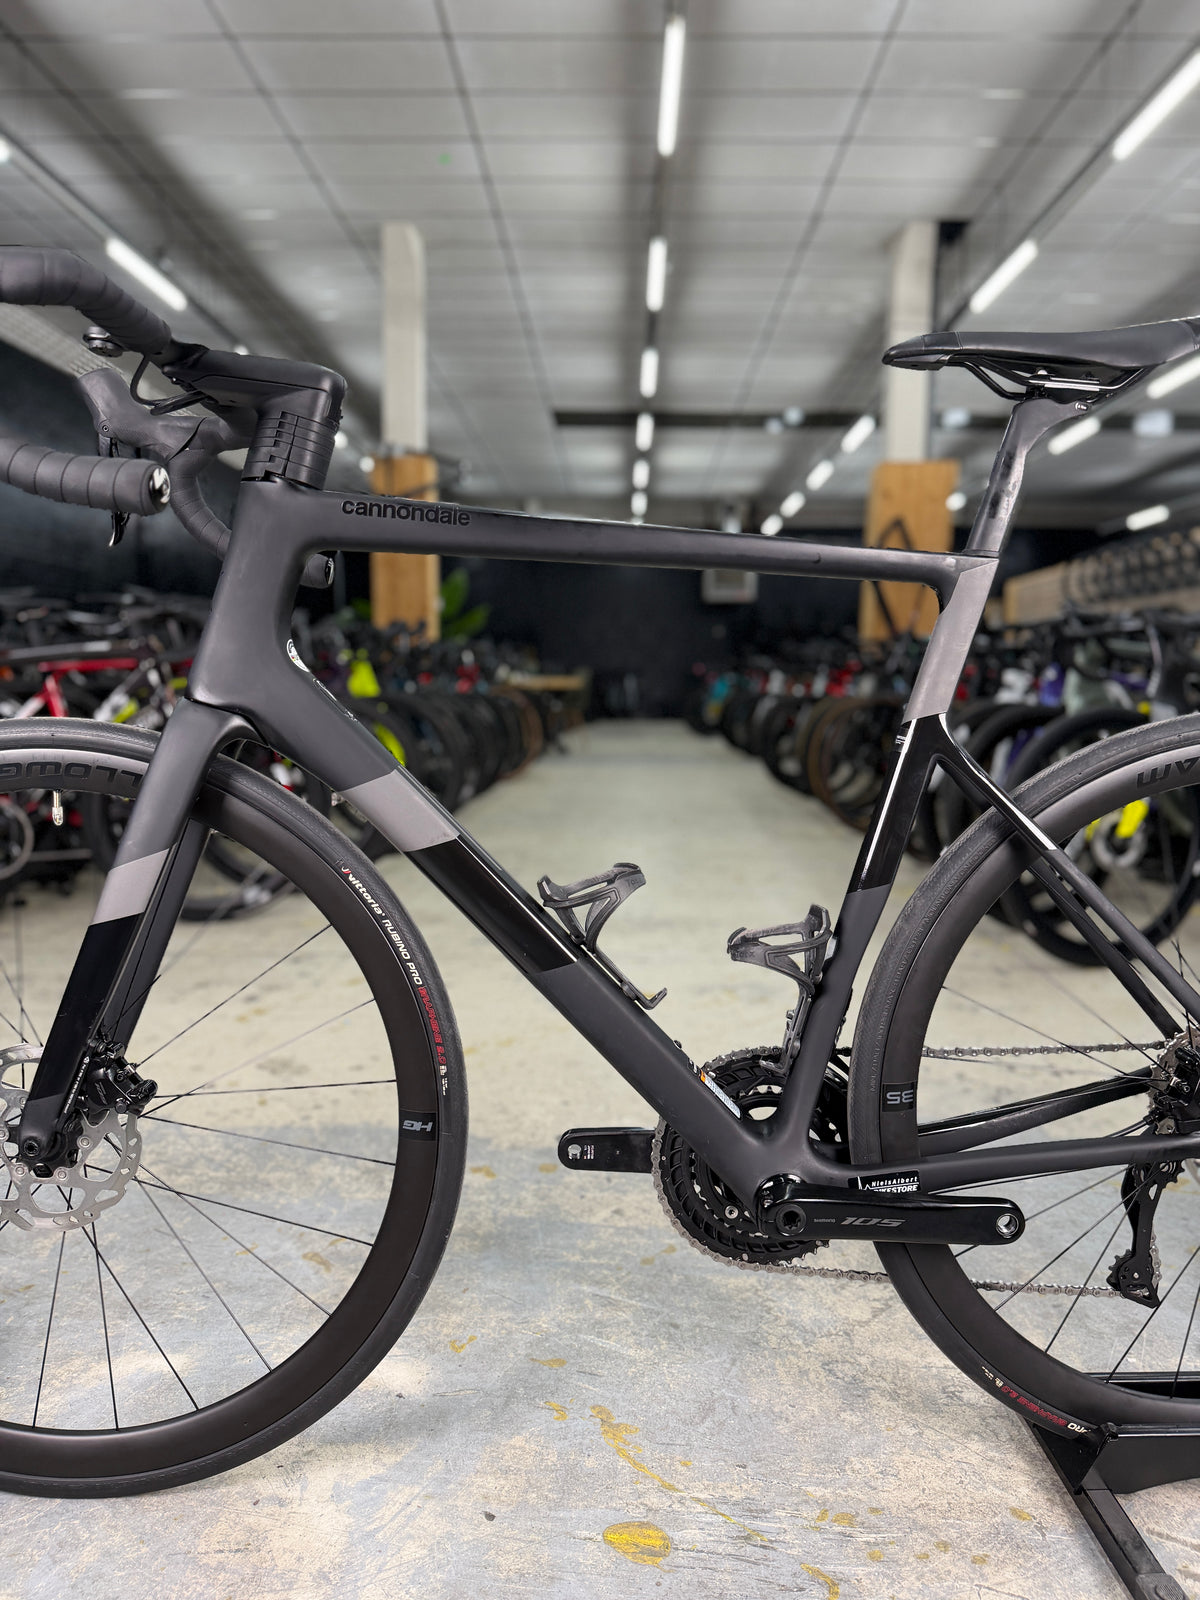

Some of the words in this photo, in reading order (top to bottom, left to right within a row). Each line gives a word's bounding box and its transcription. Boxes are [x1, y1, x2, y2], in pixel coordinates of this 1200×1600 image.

[341, 500, 471, 526] cannondale
[349, 874, 384, 916] vittoria
[381, 919, 411, 960] RUBINO
[406, 962, 423, 985] PRO
[886, 1089, 914, 1105] 35
[402, 1119, 433, 1132] HG
[840, 1216, 906, 1228] 105
